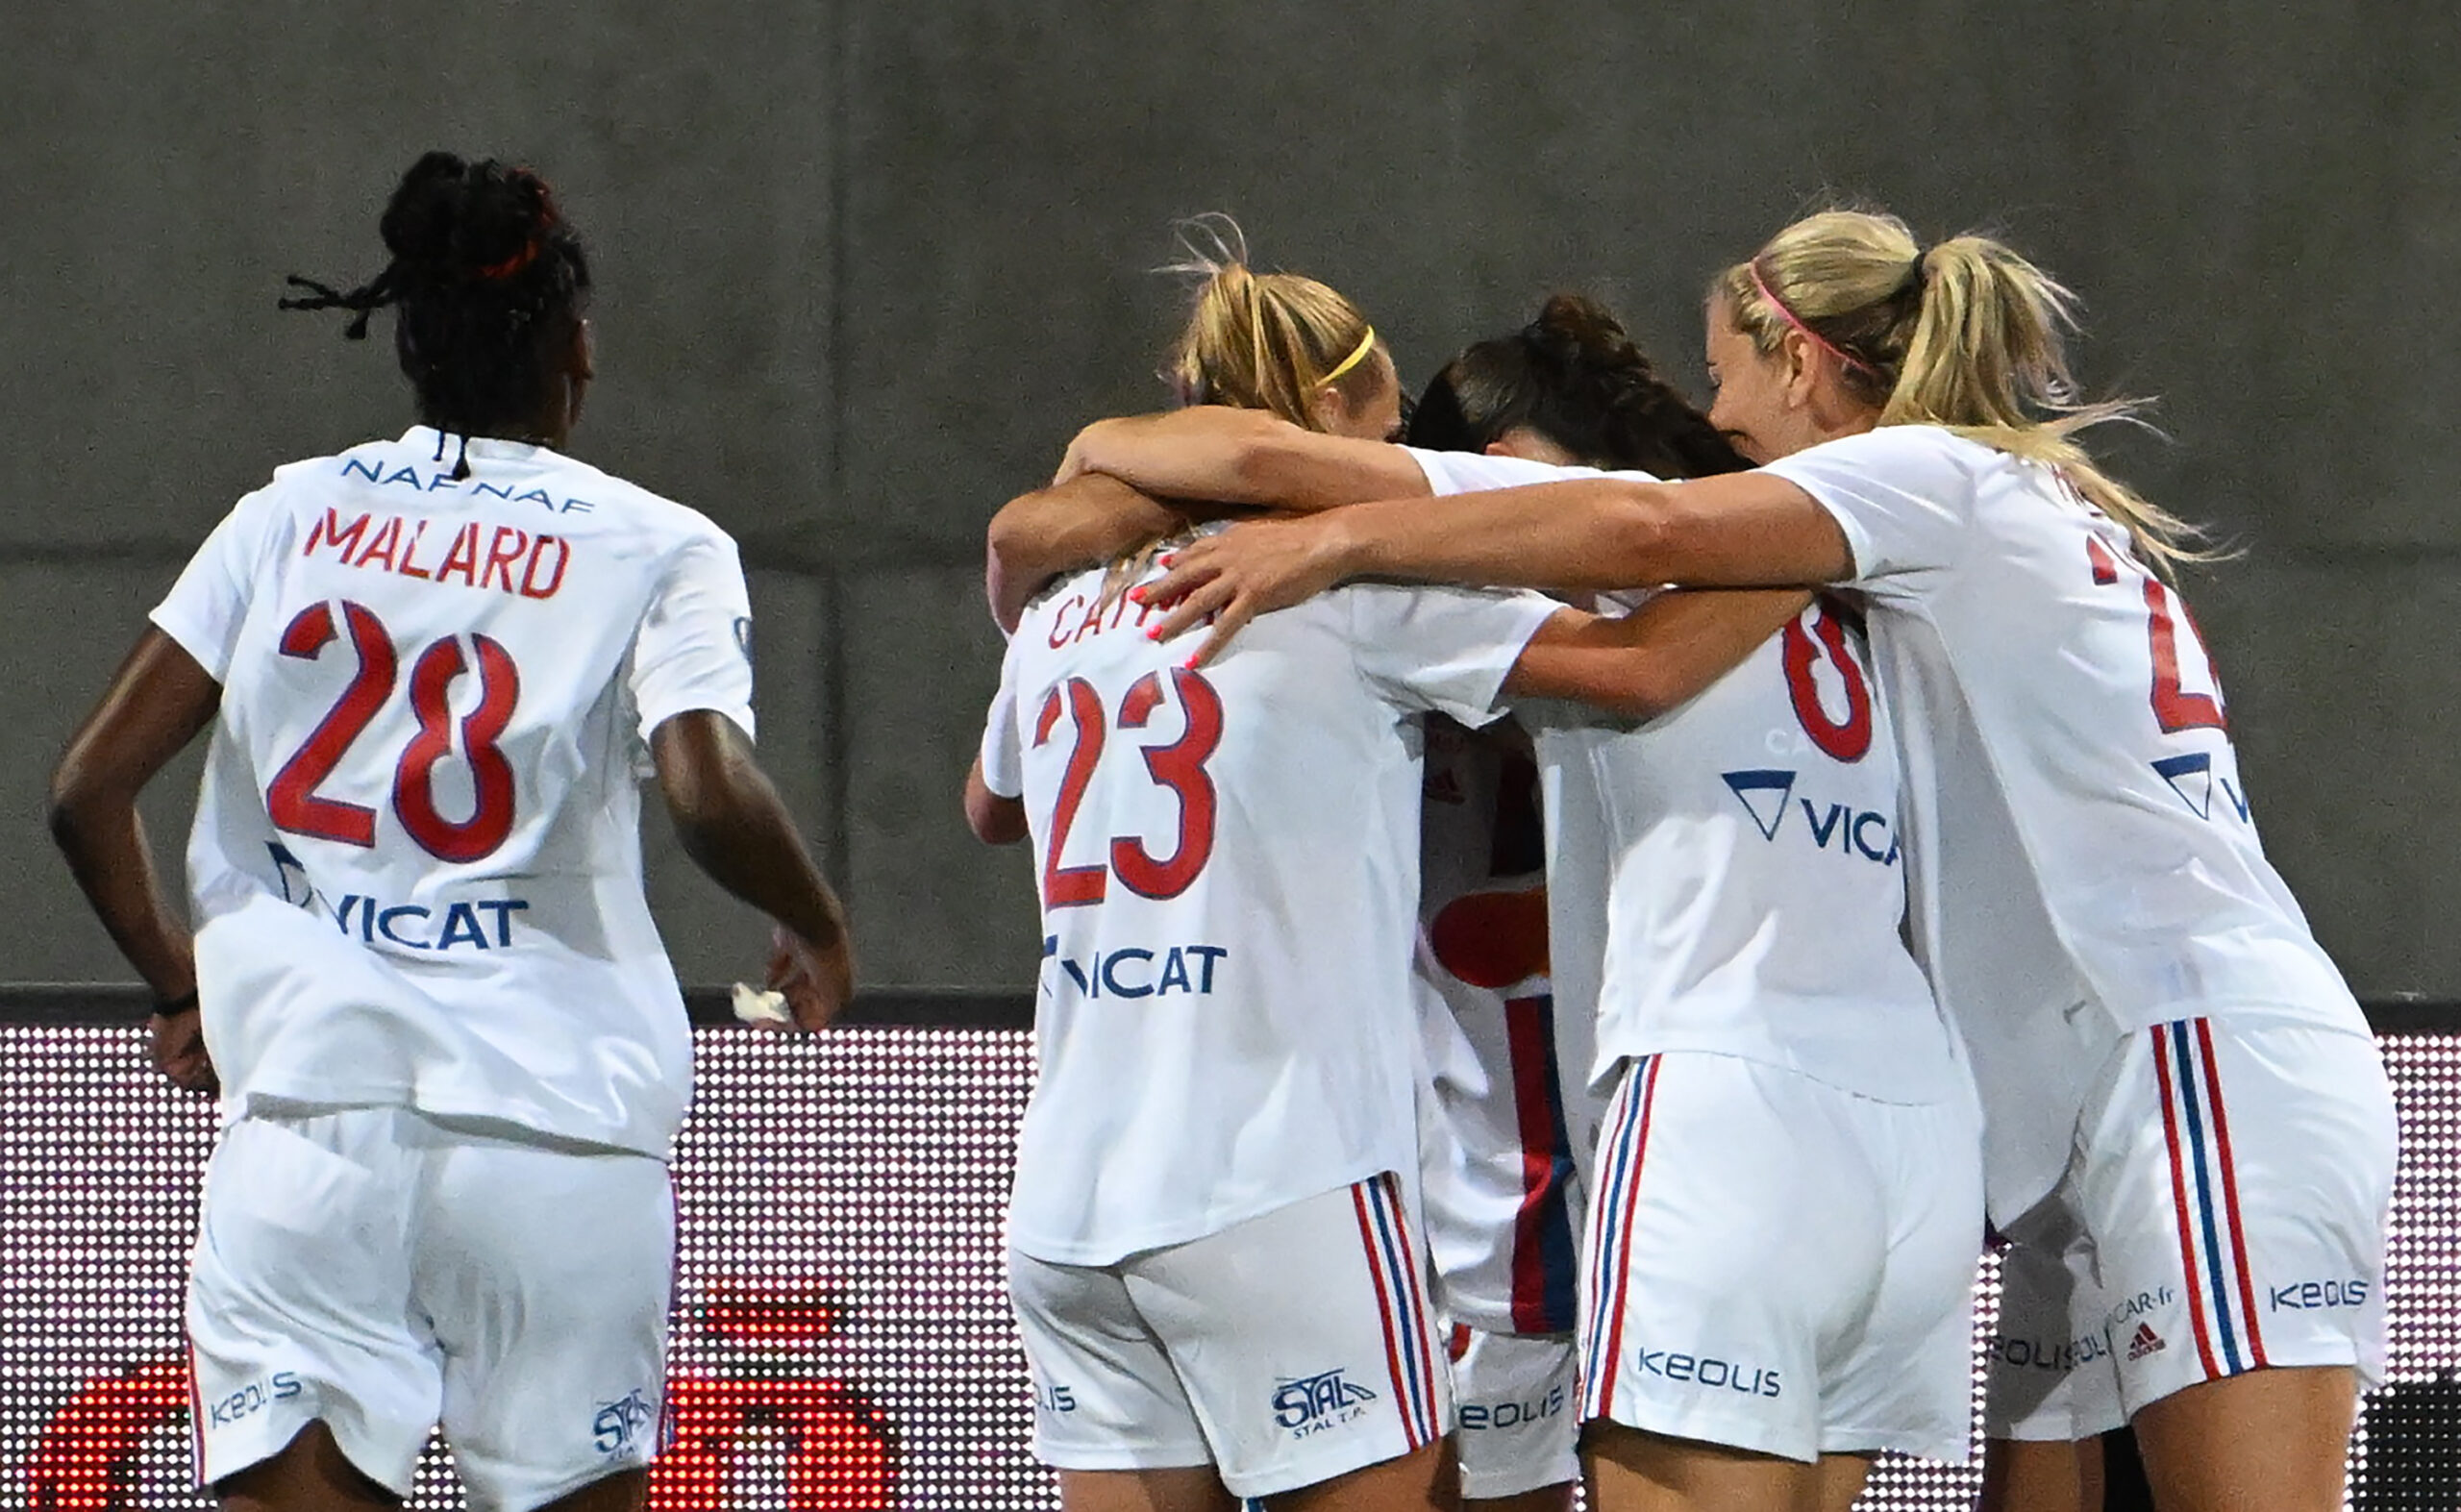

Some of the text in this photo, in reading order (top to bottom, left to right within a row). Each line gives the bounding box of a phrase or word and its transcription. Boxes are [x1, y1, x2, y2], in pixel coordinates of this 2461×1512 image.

[340, 459, 596, 514] NAF NAF
[303, 506, 571, 600] MALARD
[265, 599, 521, 865] 28
[1032, 665, 1224, 914] 23
[313, 888, 530, 951] VICAT
[1061, 945, 1229, 1000] VICAT
[1293, 1417, 1335, 1440] STAL
[1457, 1384, 1565, 1431] eOLIS
